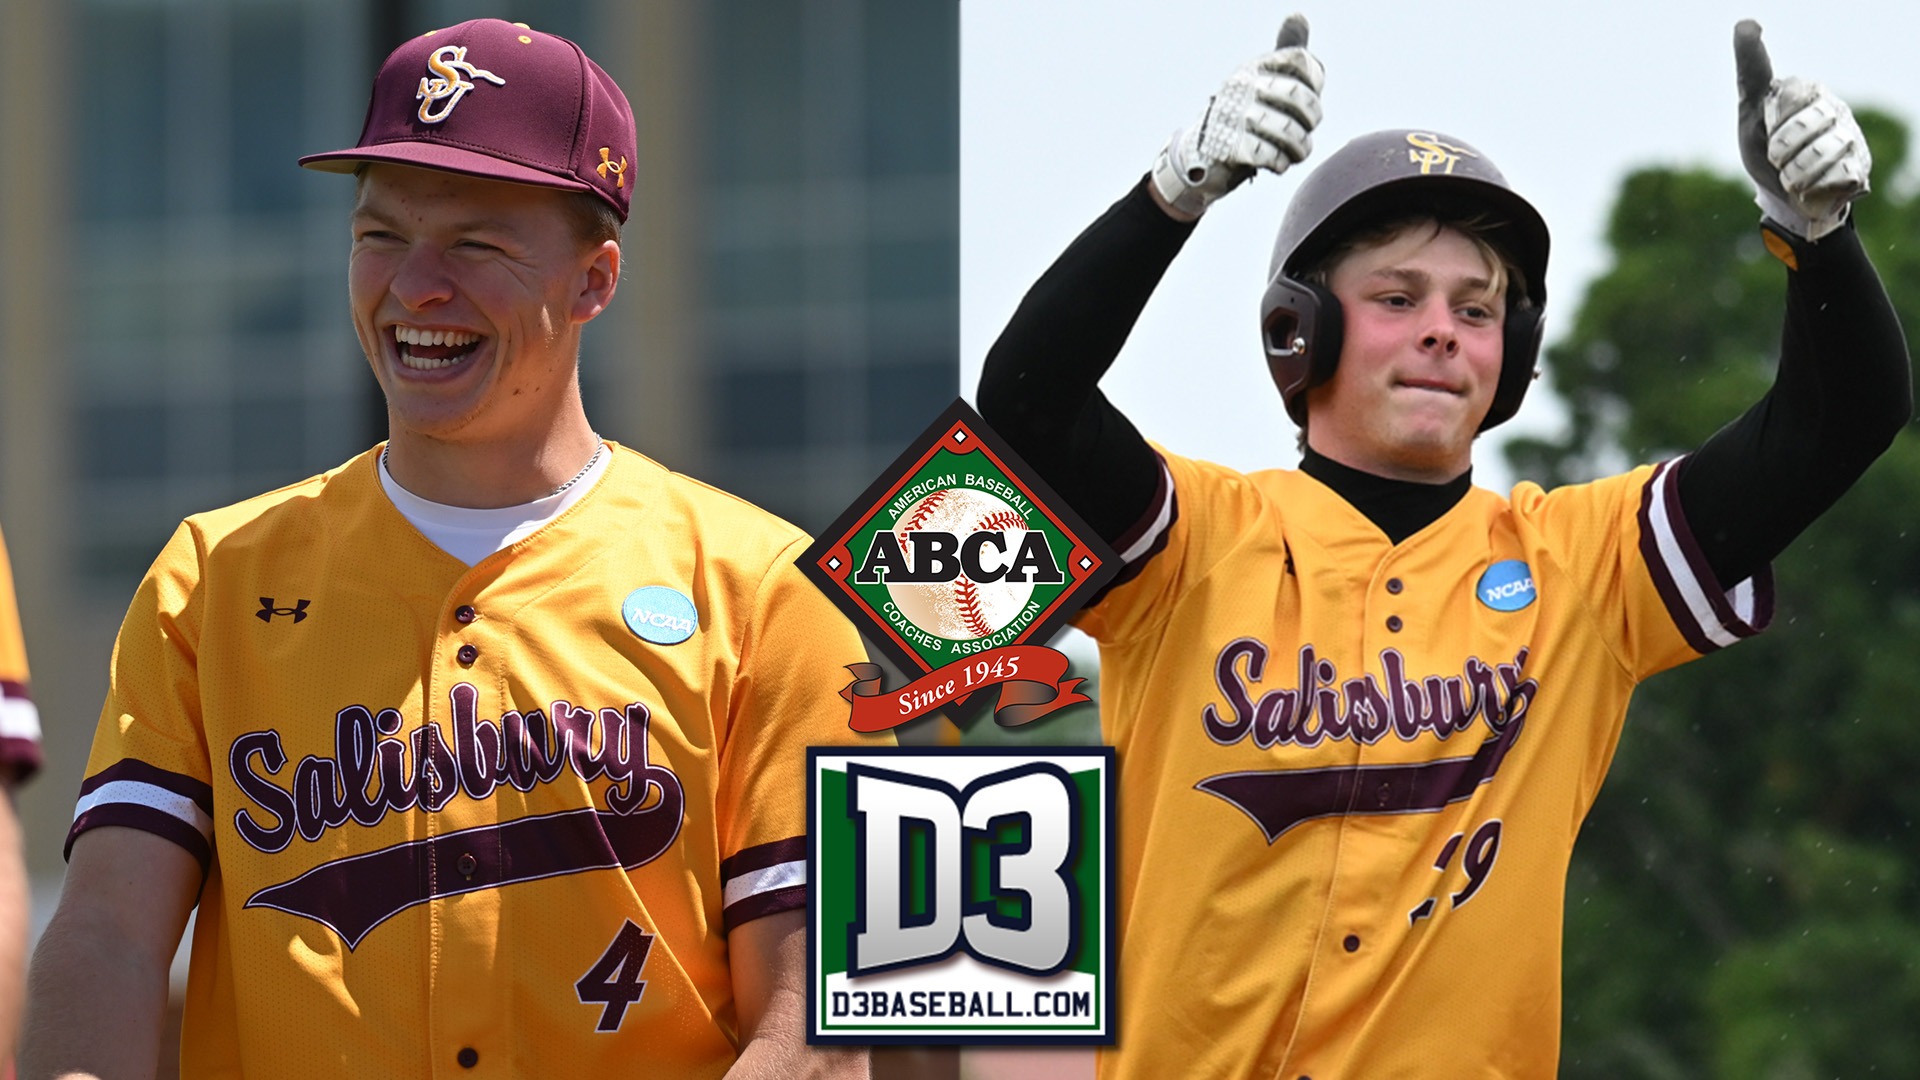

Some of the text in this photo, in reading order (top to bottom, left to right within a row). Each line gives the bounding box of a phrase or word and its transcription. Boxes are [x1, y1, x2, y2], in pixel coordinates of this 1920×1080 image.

[631, 607, 691, 634] NCAA
[229, 682, 668, 854] Salisbury
[573, 917, 656, 1033] 4
